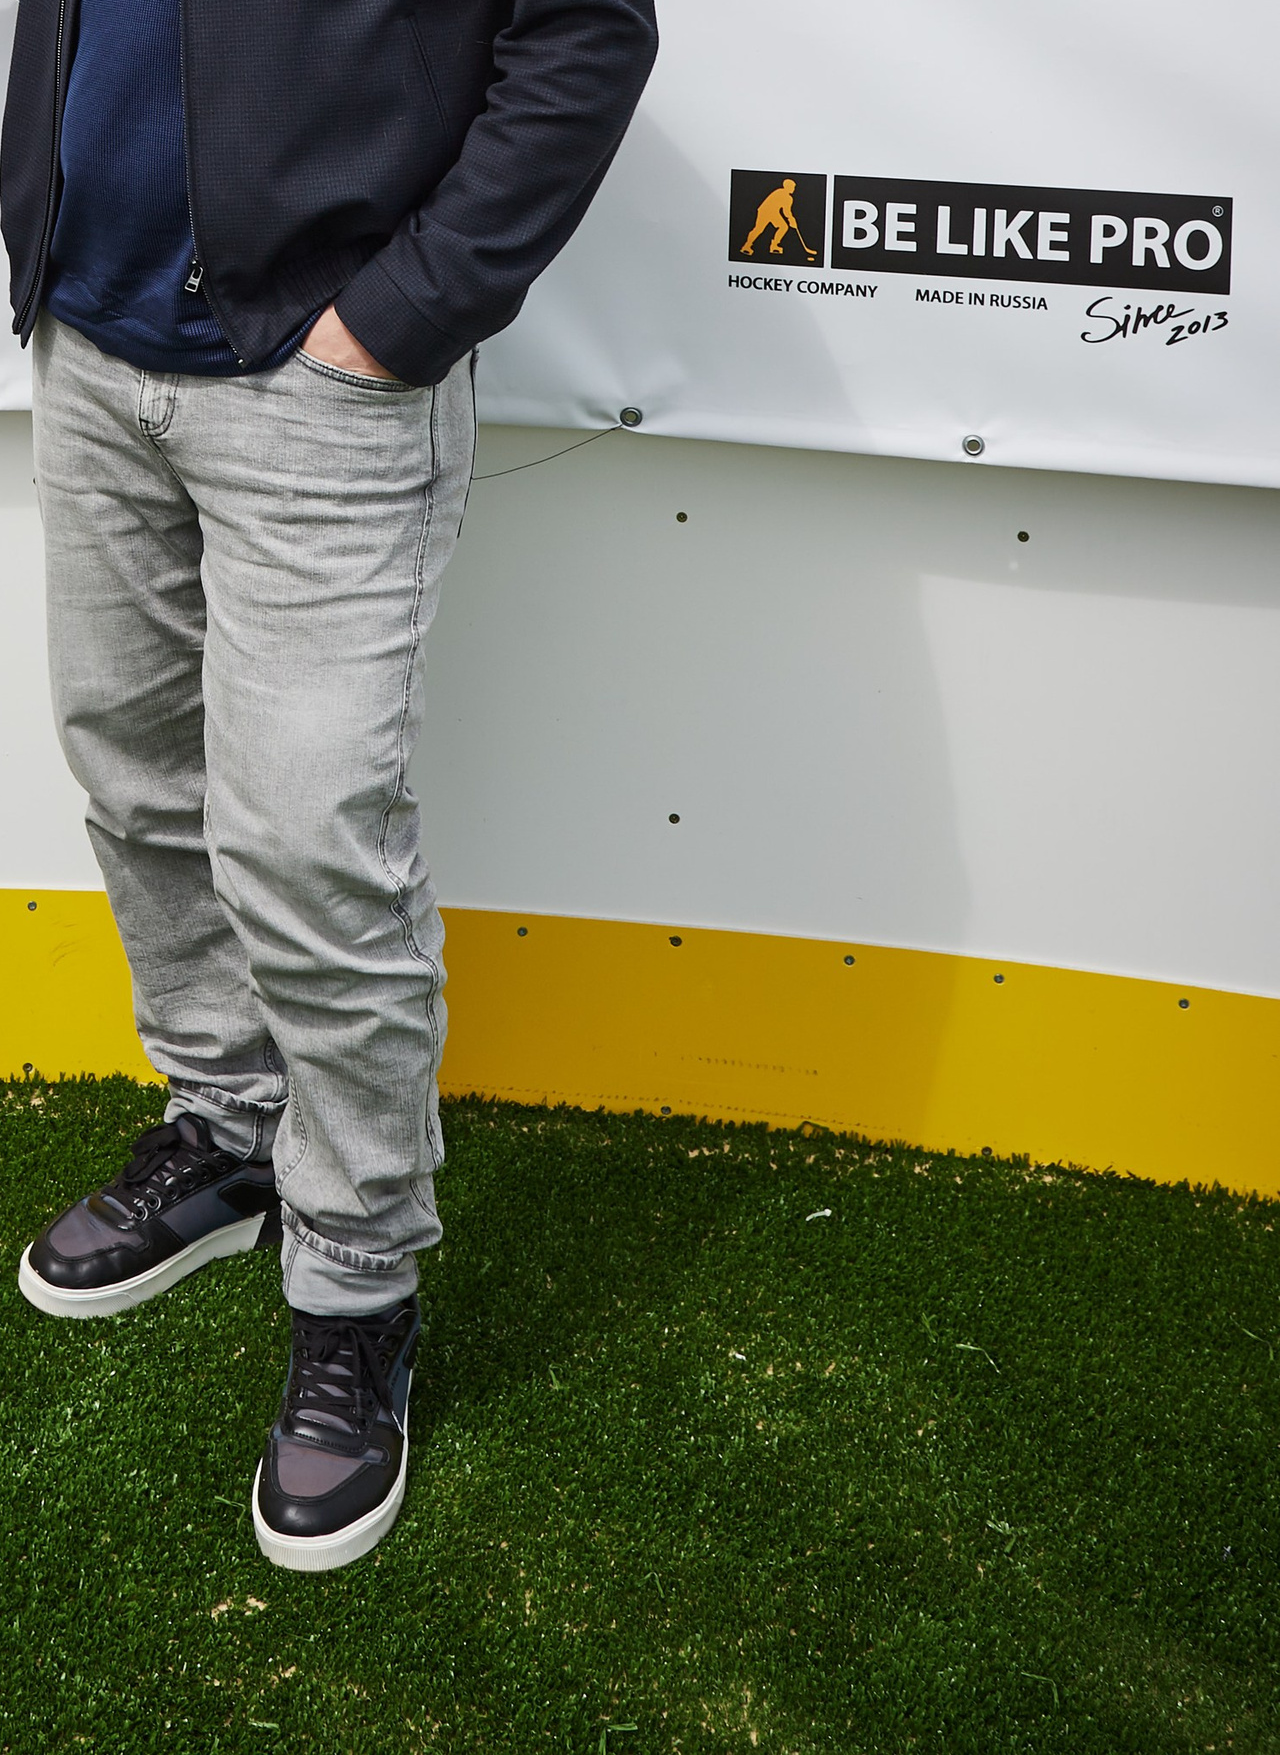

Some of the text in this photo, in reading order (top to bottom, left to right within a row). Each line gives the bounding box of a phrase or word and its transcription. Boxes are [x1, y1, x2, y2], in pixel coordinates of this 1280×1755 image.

[842, 199, 917, 252] BE
[936, 205, 1071, 262] LIKE
[728, 274, 879, 299] HOCKEY COMPANY
[915, 288, 1048, 311] MADE IN RUSSIA
[1080, 295, 1230, 347] Since 2013
